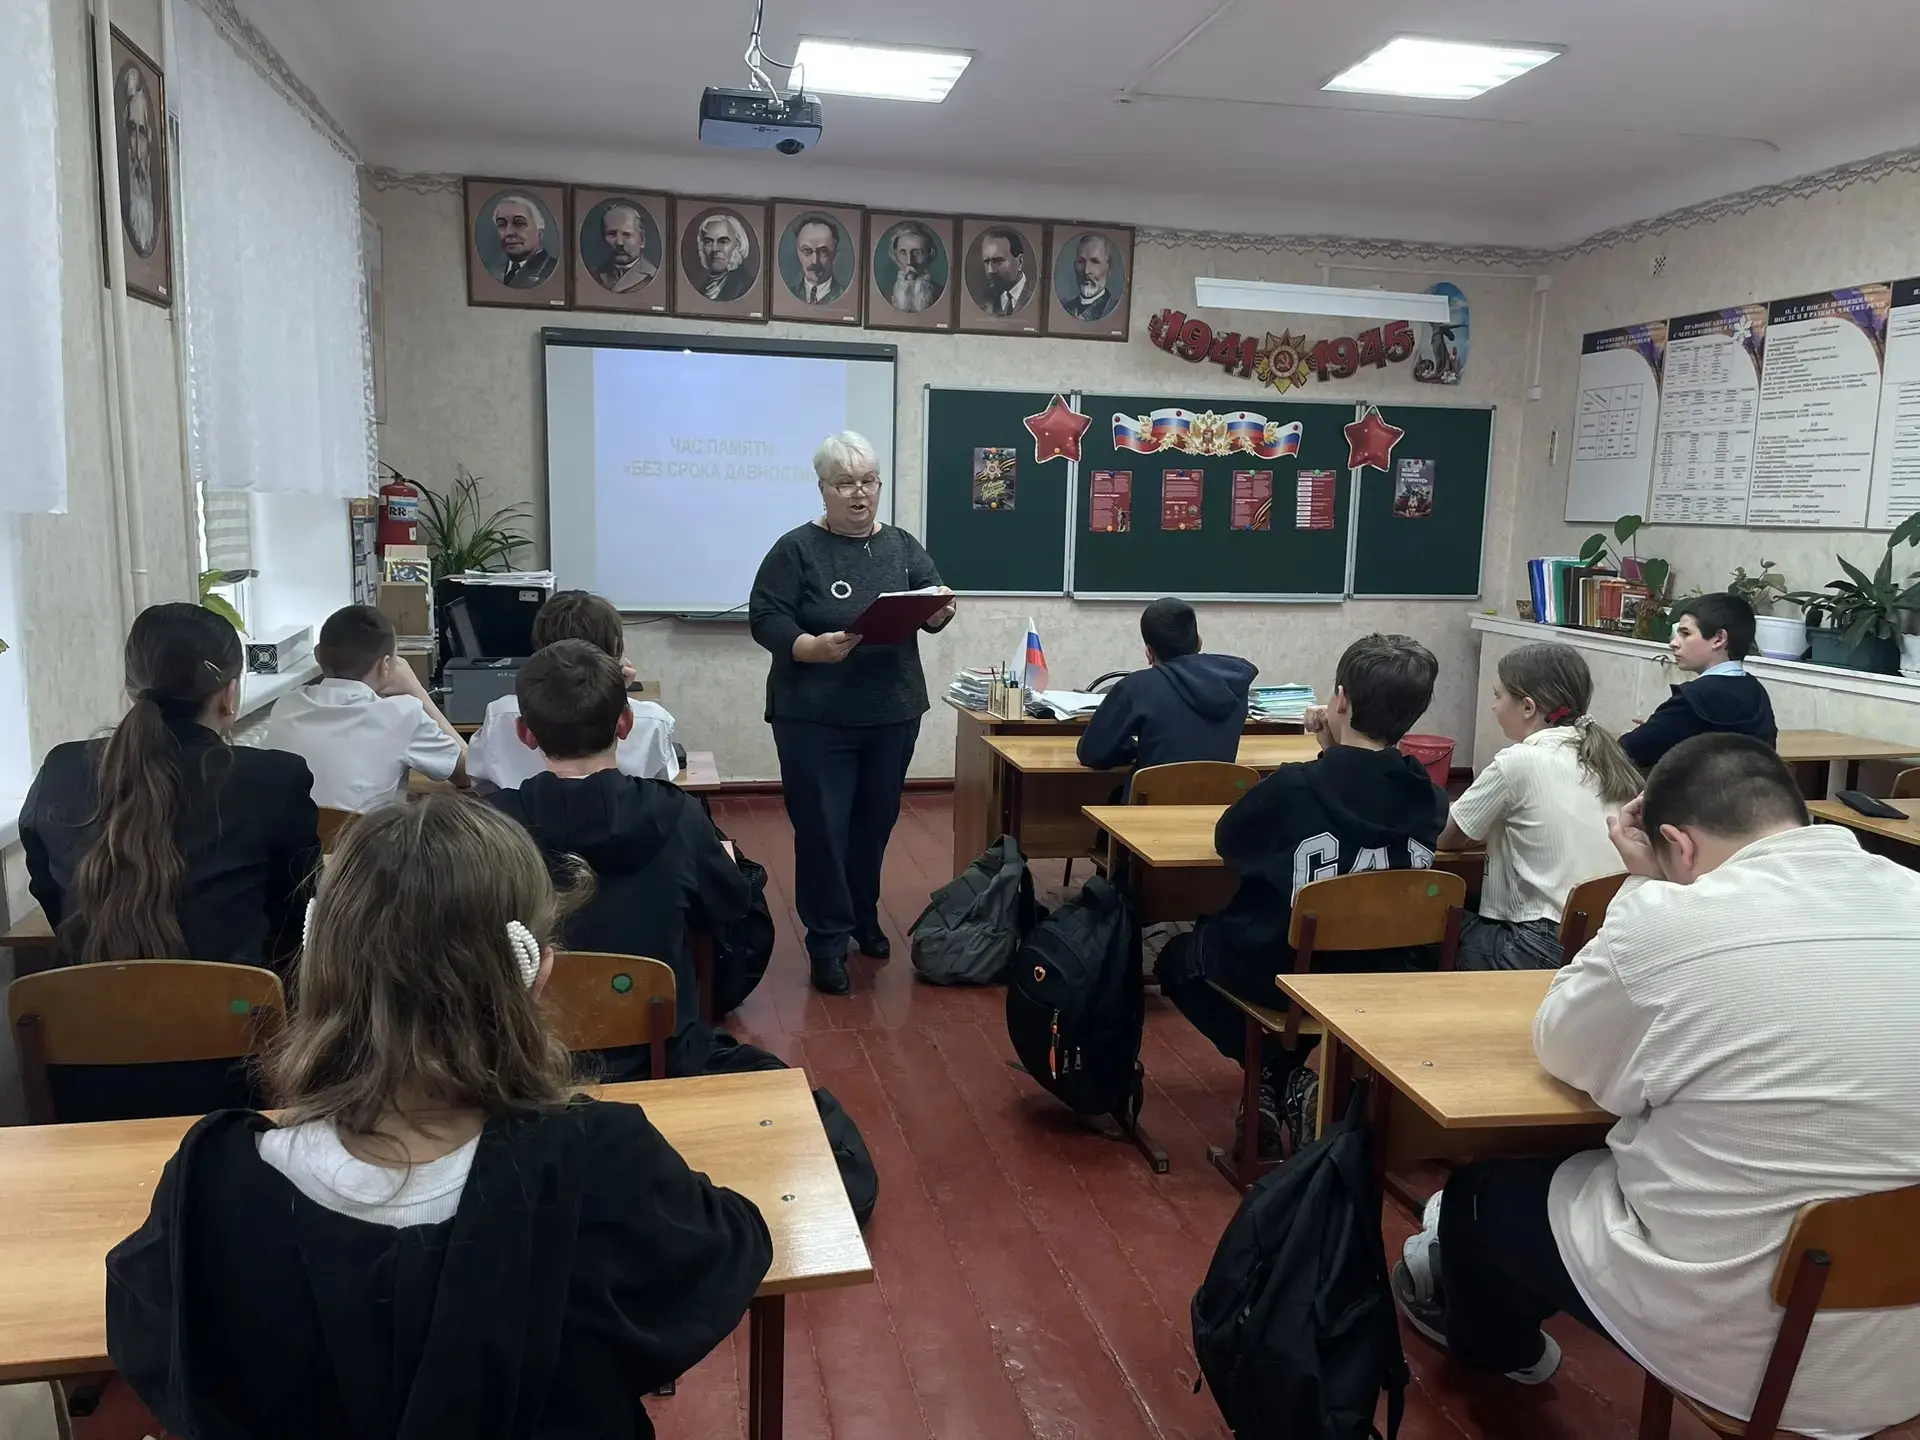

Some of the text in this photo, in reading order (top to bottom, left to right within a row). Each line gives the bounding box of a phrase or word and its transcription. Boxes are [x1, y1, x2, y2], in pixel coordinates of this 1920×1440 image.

[1773, 314, 1796, 323] ПОСЛЕ
[1159, 308, 1414, 382] 1941 1945
[670, 437, 773, 458] ЧАС ПАМЯТИ
[667, 461, 721, 480] СРОКА
